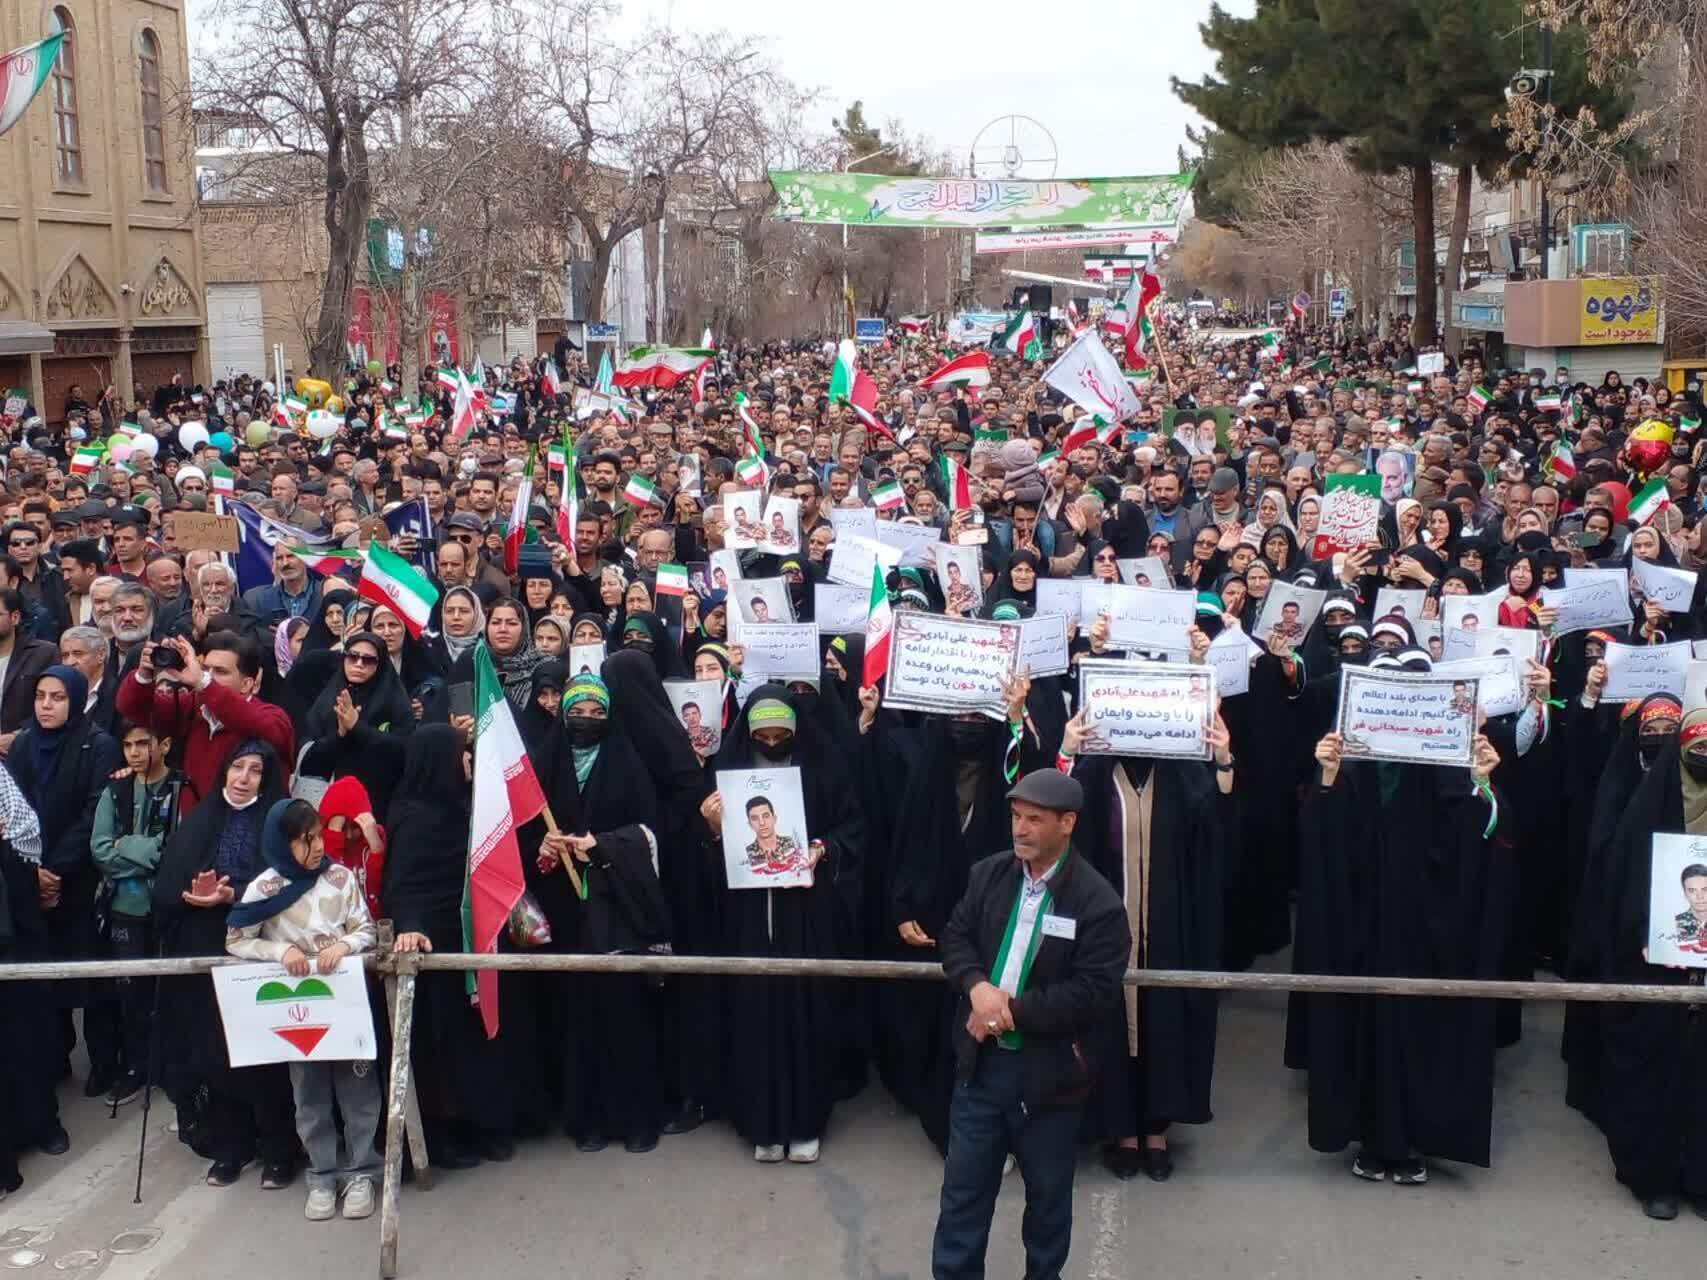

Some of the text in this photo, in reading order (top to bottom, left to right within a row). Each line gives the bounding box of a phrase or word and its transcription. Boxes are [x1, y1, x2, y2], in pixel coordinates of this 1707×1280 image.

[1586, 279, 1651, 322] قهوه
[1585, 328, 1651, 340] موجود است
[925, 631, 996, 647] شهید علی آبادی
[904, 643, 930, 653] ادامه
[992, 655, 1005, 665] راه
[905, 660, 932, 671] وعده
[934, 664, 950, 673] این
[902, 675, 1001, 693] ما به خون پاک توست
[1390, 693, 1407, 703] بلند
[1408, 694, 1438, 704] صدای
[1439, 694, 1447, 704] با
[1135, 711, 1170, 722] وحدت
[1185, 708, 1194, 722] را
[1368, 722, 1409, 734] سبحانی
[1413, 726, 1443, 736] شهید
[1447, 727, 1461, 737] راه
[1164, 729, 1196, 739] ادامه
[1421, 742, 1459, 751] هستیم
